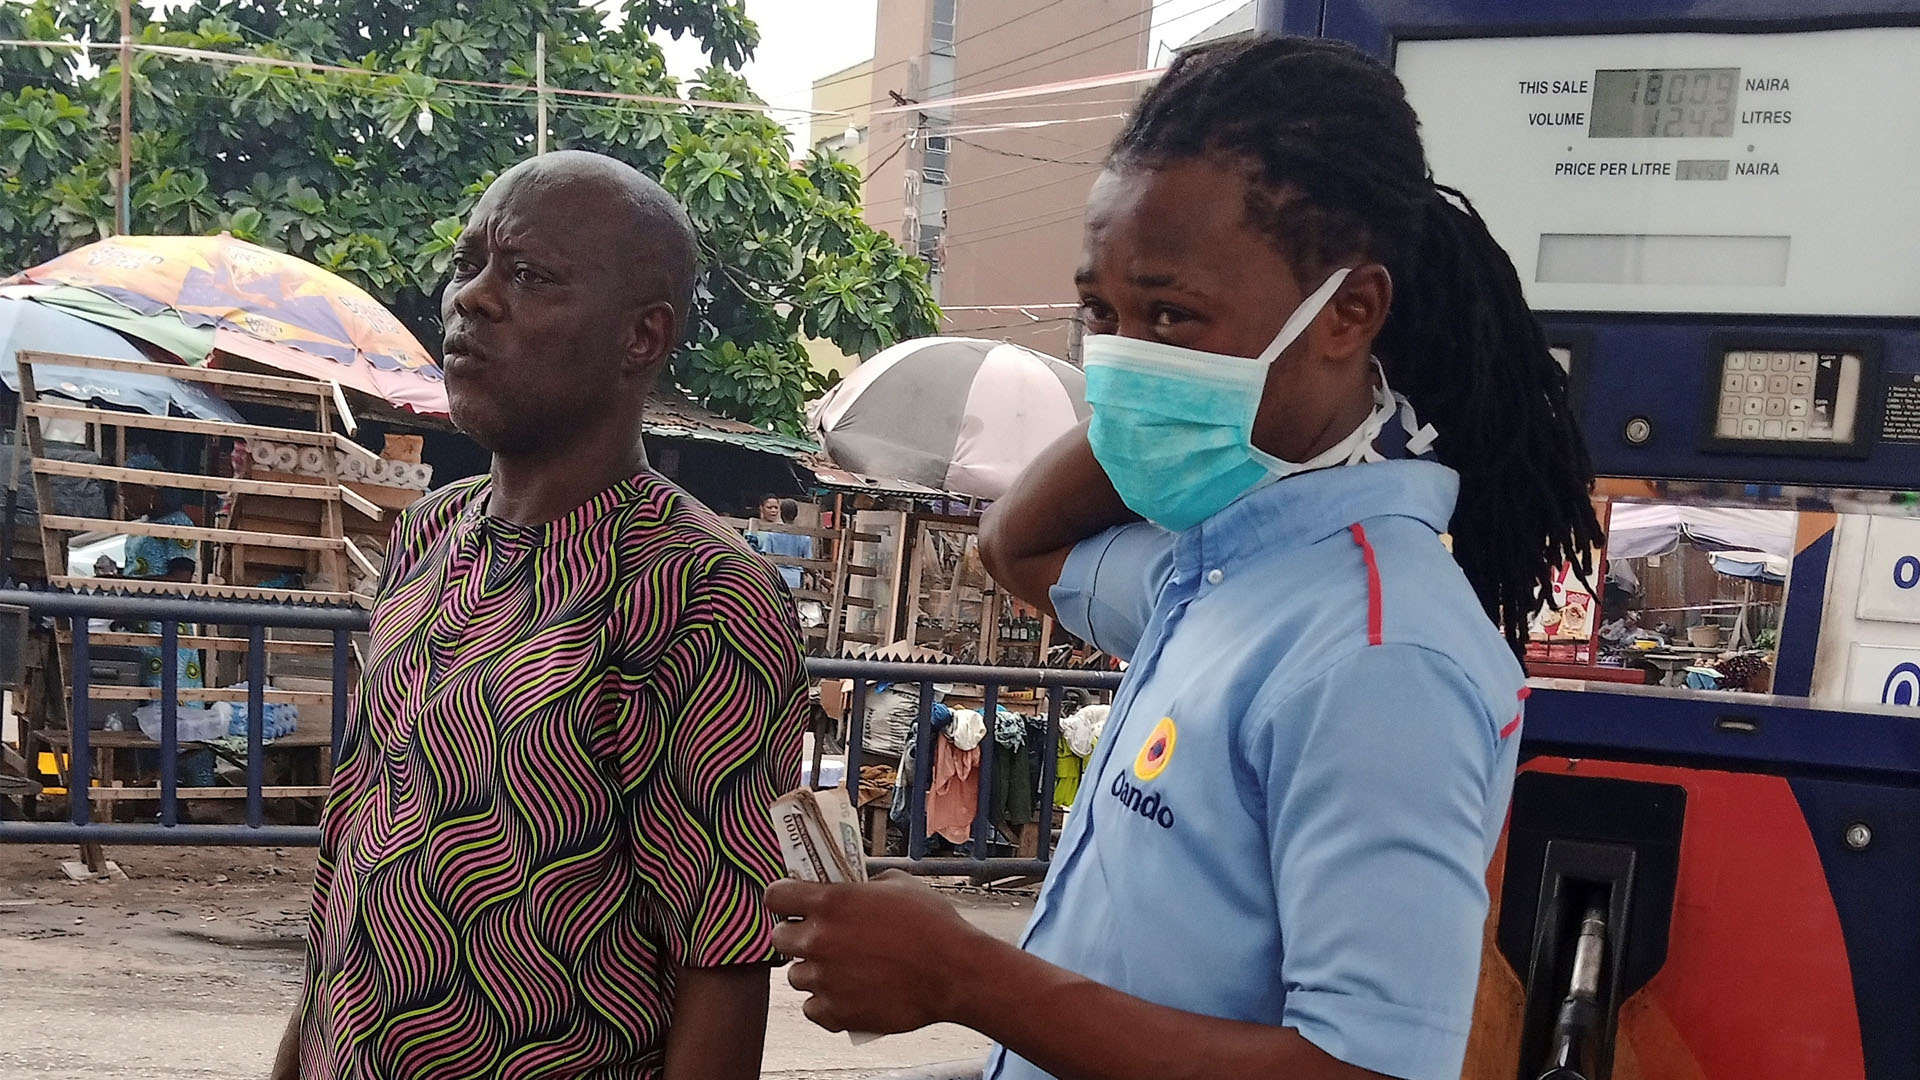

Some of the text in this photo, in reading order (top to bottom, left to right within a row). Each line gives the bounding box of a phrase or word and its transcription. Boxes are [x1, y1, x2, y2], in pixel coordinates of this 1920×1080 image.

[1519, 80, 1588, 94] THIS SALE
[1745, 78, 1790, 91] NAIRA
[1529, 112, 1585, 126] VOLUME
[1742, 110, 1792, 124] LITRES
[1555, 162, 1671, 176] PRICE PER LITRE
[1735, 162, 1780, 176] NAIRA
[1111, 769, 1175, 829] Oando
[782, 814, 803, 850] 1000
